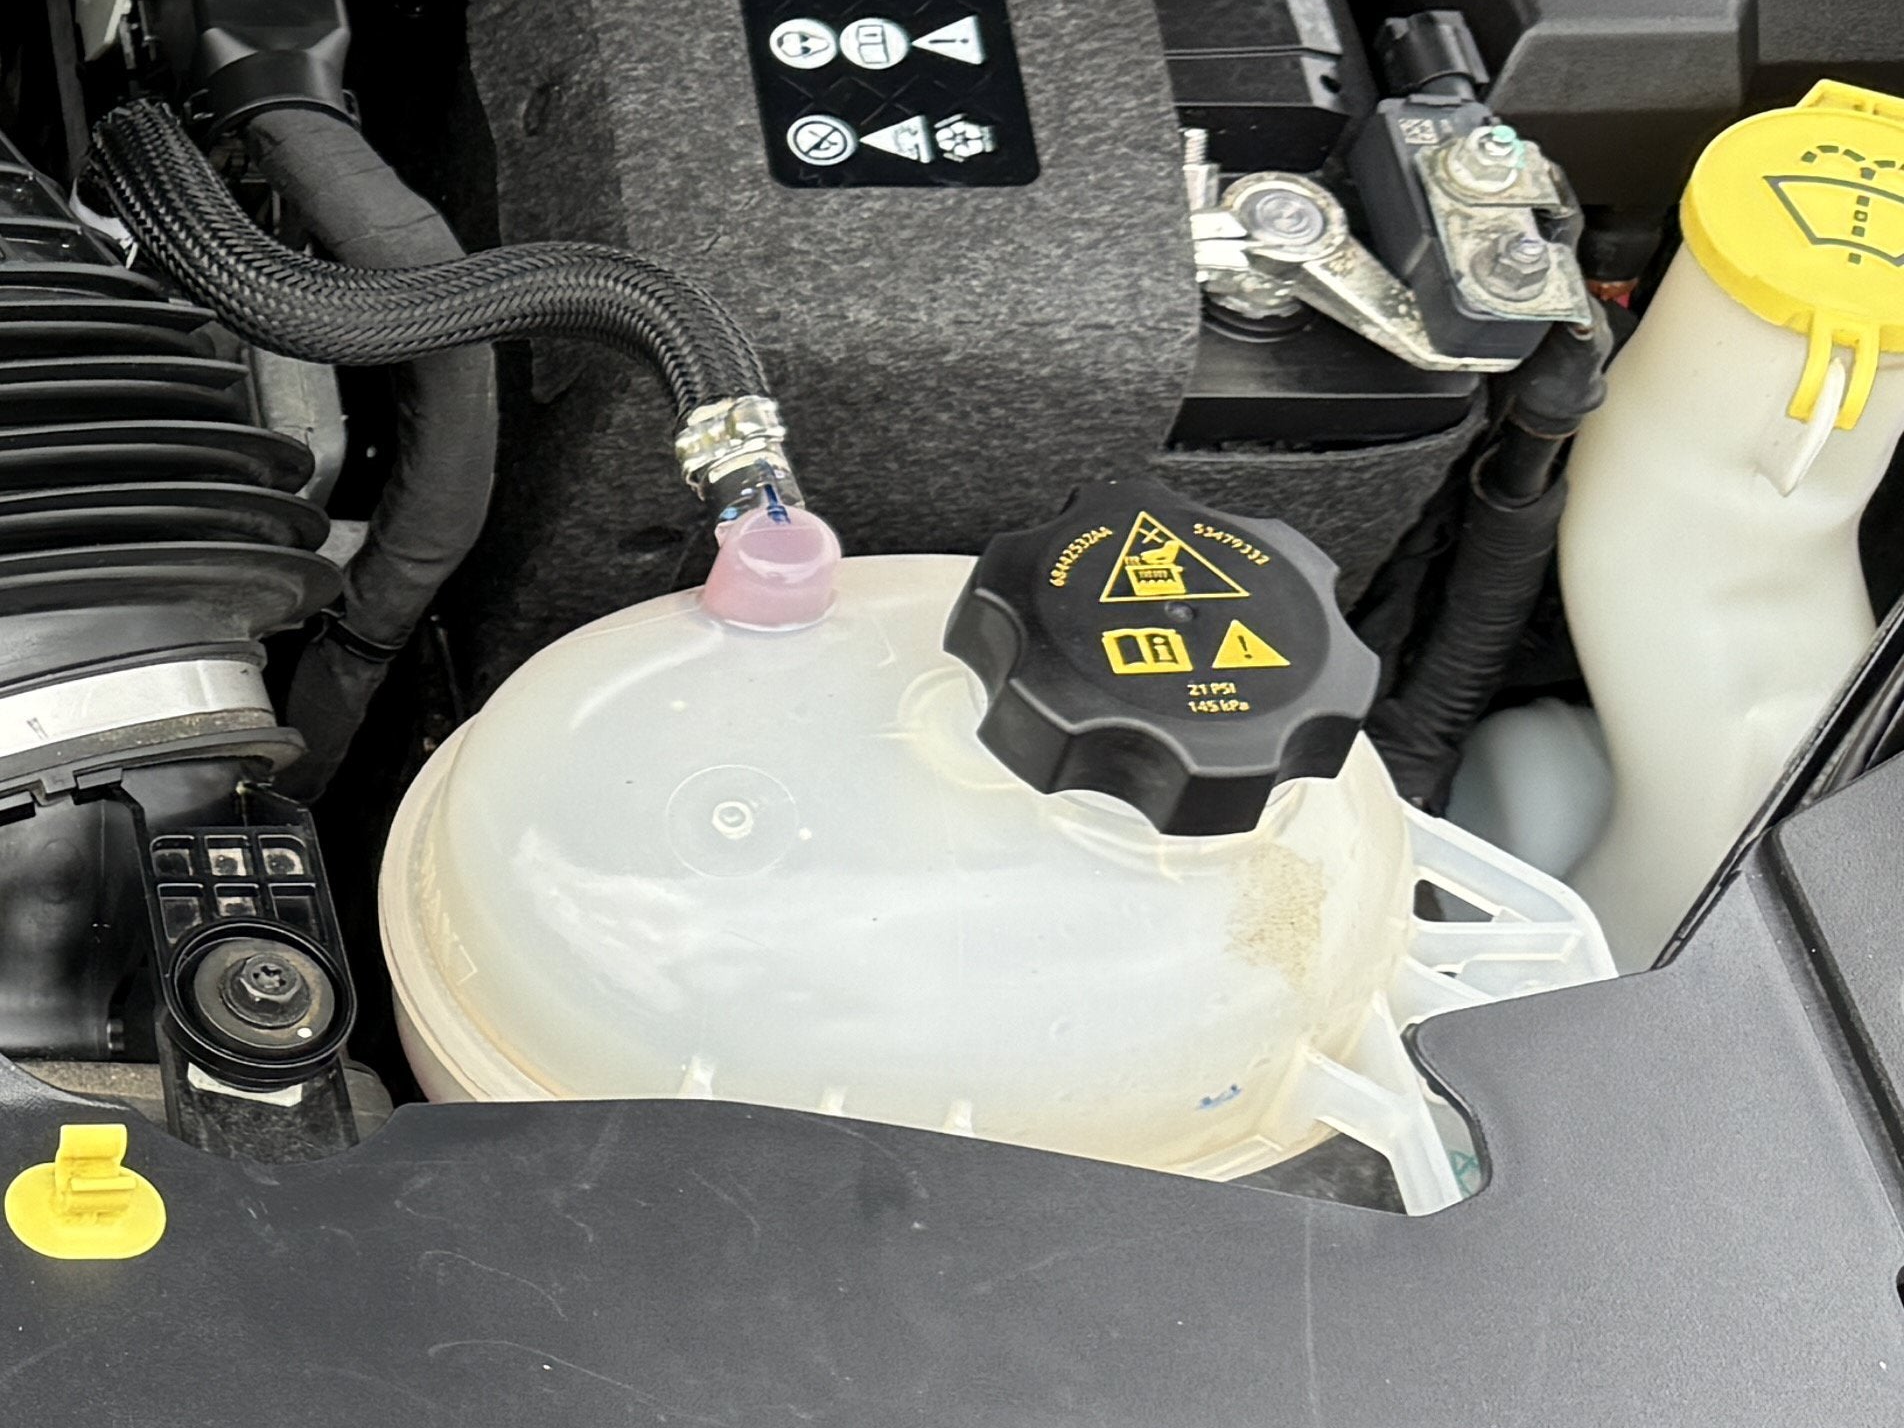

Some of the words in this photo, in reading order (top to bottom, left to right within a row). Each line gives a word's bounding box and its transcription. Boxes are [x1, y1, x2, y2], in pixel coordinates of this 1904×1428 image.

[1187, 684, 1208, 696] 21
[1210, 682, 1237, 695] PSI
[1188, 700, 1220, 713] 145
